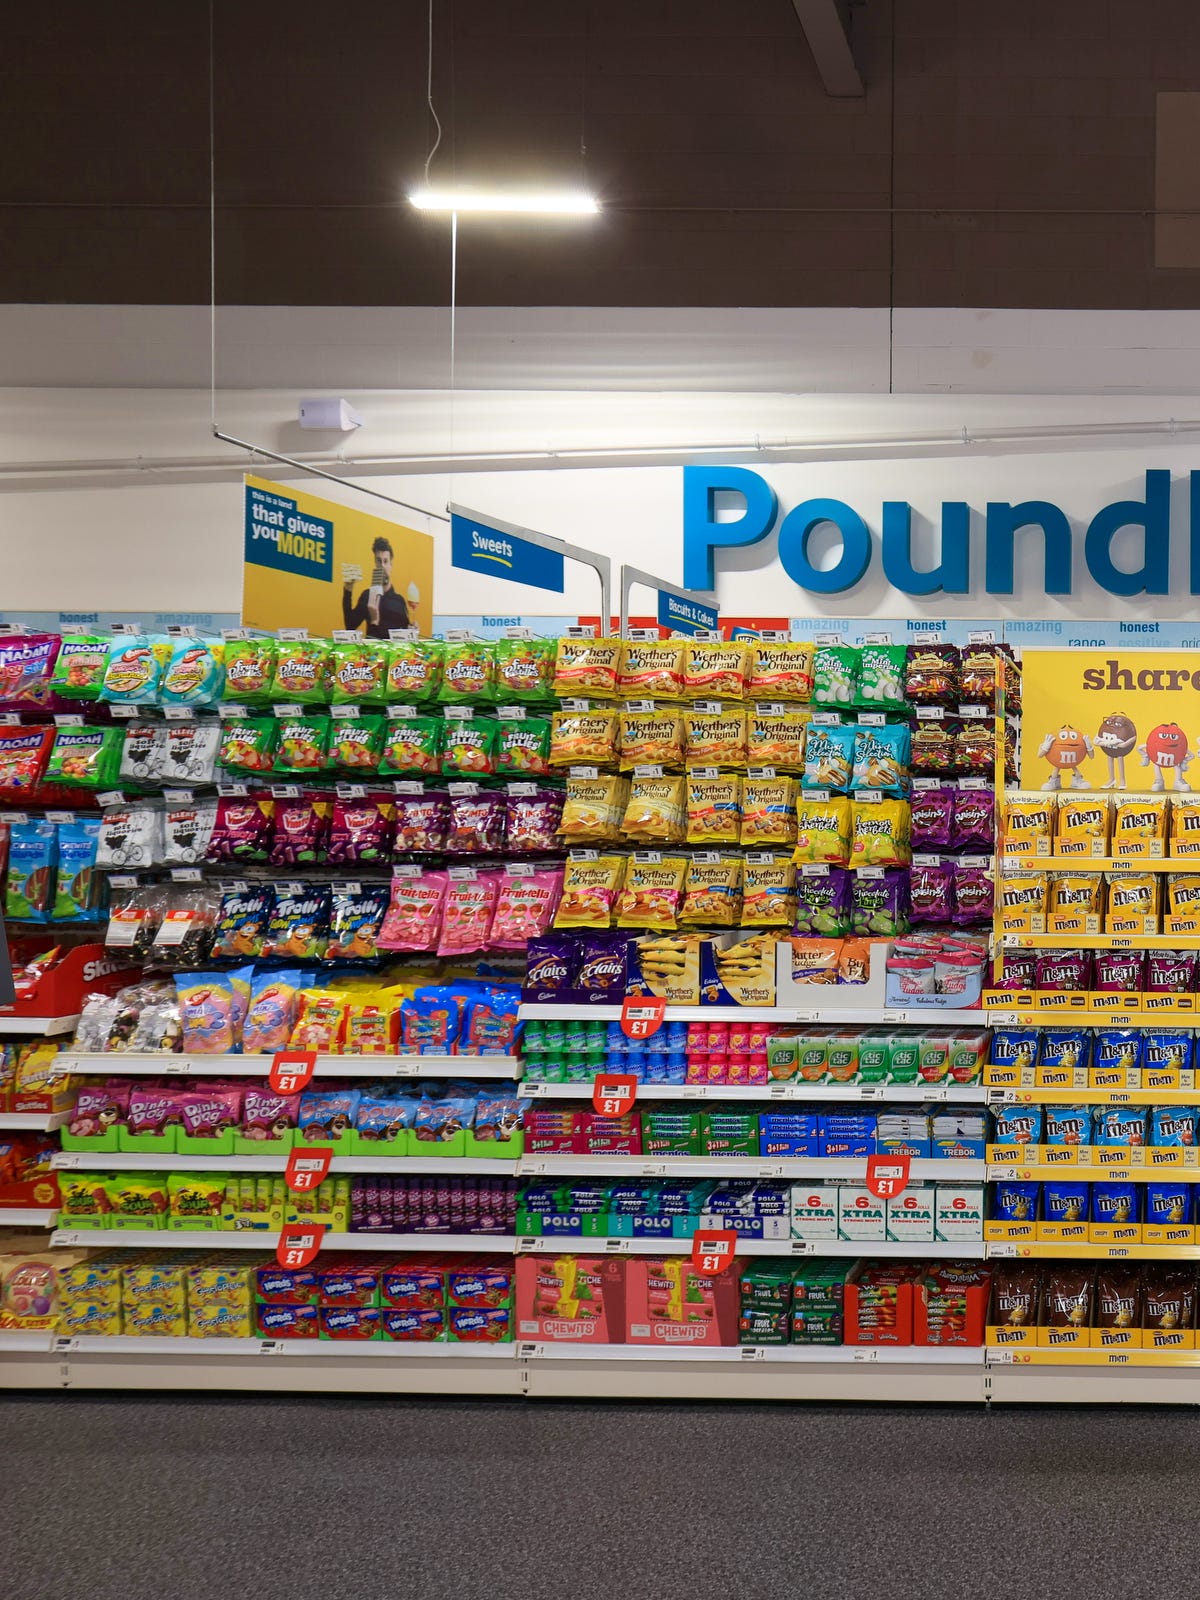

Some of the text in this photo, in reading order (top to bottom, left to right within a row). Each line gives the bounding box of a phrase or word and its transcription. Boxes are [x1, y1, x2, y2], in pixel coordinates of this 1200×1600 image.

[252, 492, 265, 501] this
[266, 495, 272, 503] is
[278, 498, 292, 509] land
[252, 504, 325, 538] that gives
[472, 531, 513, 557] Sweets
[60, 612, 98, 622] honest
[155, 612, 212, 625] amazing
[669, 598, 714, 627] Biscuits & Cakes
[792, 619, 946, 632] amazing honest
[1005, 622, 1160, 634] amazing honest
[1068, 637, 1106, 646] range
[64, 644, 108, 653] MAOAM
[627, 648, 677, 661] Werther's
[757, 650, 808, 661] Werther's
[637, 659, 674, 670] Original
[767, 660, 805, 671] Original
[690, 720, 741, 731] Werther's
[396, 728, 423, 737] FRUIT
[701, 730, 739, 740] Original
[59, 734, 102, 746] MAOAM
[1060, 751, 1076, 763] m
[1157, 751, 1174, 766] m
[689, 784, 732, 794] Werther's
[802, 812, 839, 824] Lemon
[501, 886, 550, 899] Fruit-tella
[223, 898, 264, 914] Trolli
[277, 899, 317, 917] Trolli
[538, 992, 556, 1001] Cadbury
[631, 1021, 648, 1034] £1
[279, 1076, 296, 1089] £1
[131, 1100, 174, 1116] Dinky
[603, 1101, 620, 1113] £1
[133, 1110, 168, 1124] Dog
[189, 1110, 220, 1127] Dog
[294, 1174, 312, 1187] £1
[877, 1181, 894, 1194] £1
[807, 1195, 822, 1207] 6
[952, 1197, 967, 1210] 6
[794, 1209, 835, 1217] XTRA
[939, 1211, 981, 1219] XTRA
[543, 1216, 581, 1227] POLO
[634, 1218, 671, 1228] POLO
[724, 1219, 761, 1229] POLO
[286, 1250, 304, 1264] £1
[703, 1257, 720, 1270] £1
